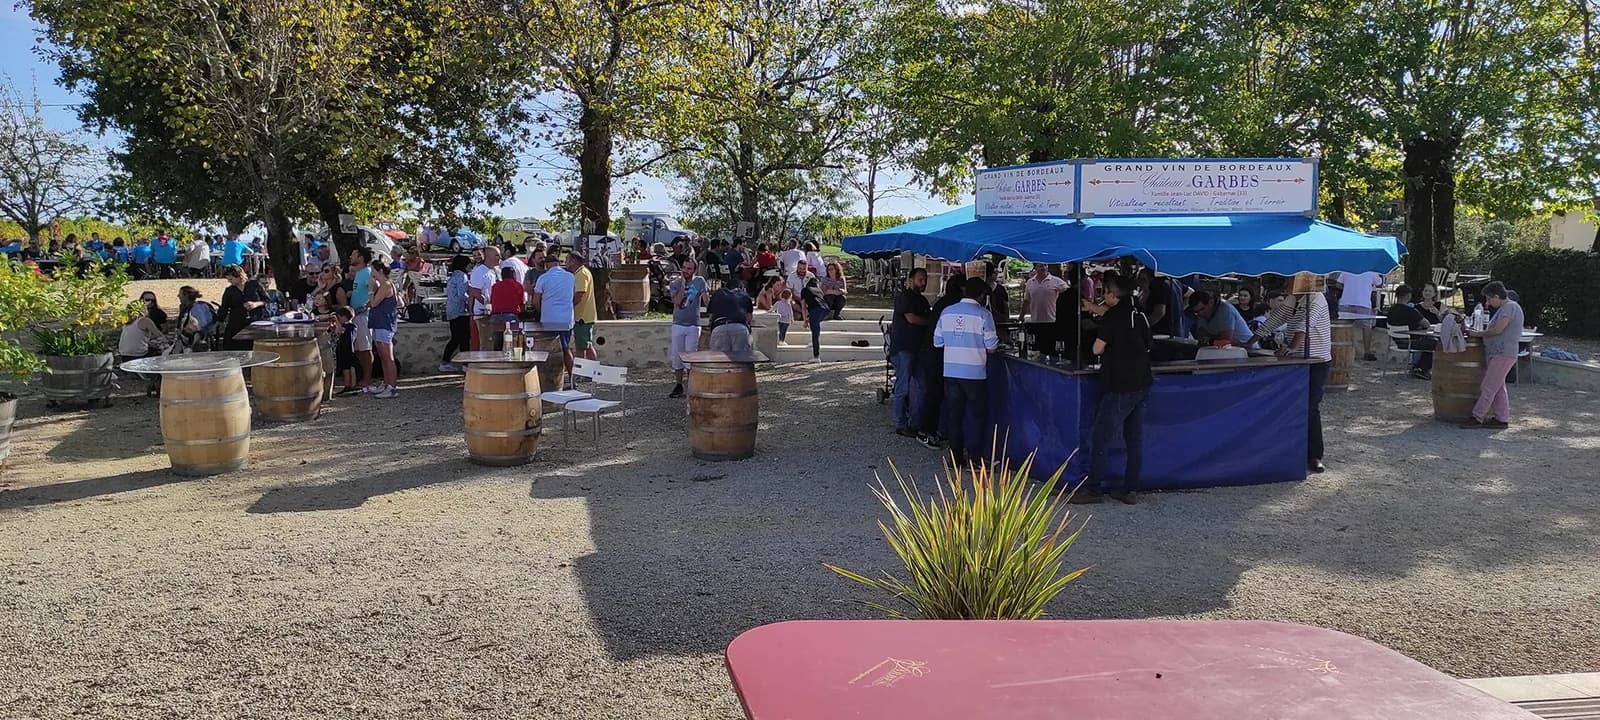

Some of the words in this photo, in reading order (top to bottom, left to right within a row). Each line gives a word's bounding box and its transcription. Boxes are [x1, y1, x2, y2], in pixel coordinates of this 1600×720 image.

[984, 172, 1001, 180] GRAND
[1027, 167, 1064, 177] BORDEAUX
[1104, 164, 1153, 172] GRAND
[1162, 164, 1185, 172] VIN
[1015, 178, 1046, 194] GARBES
[1192, 174, 1259, 190] GARBES
